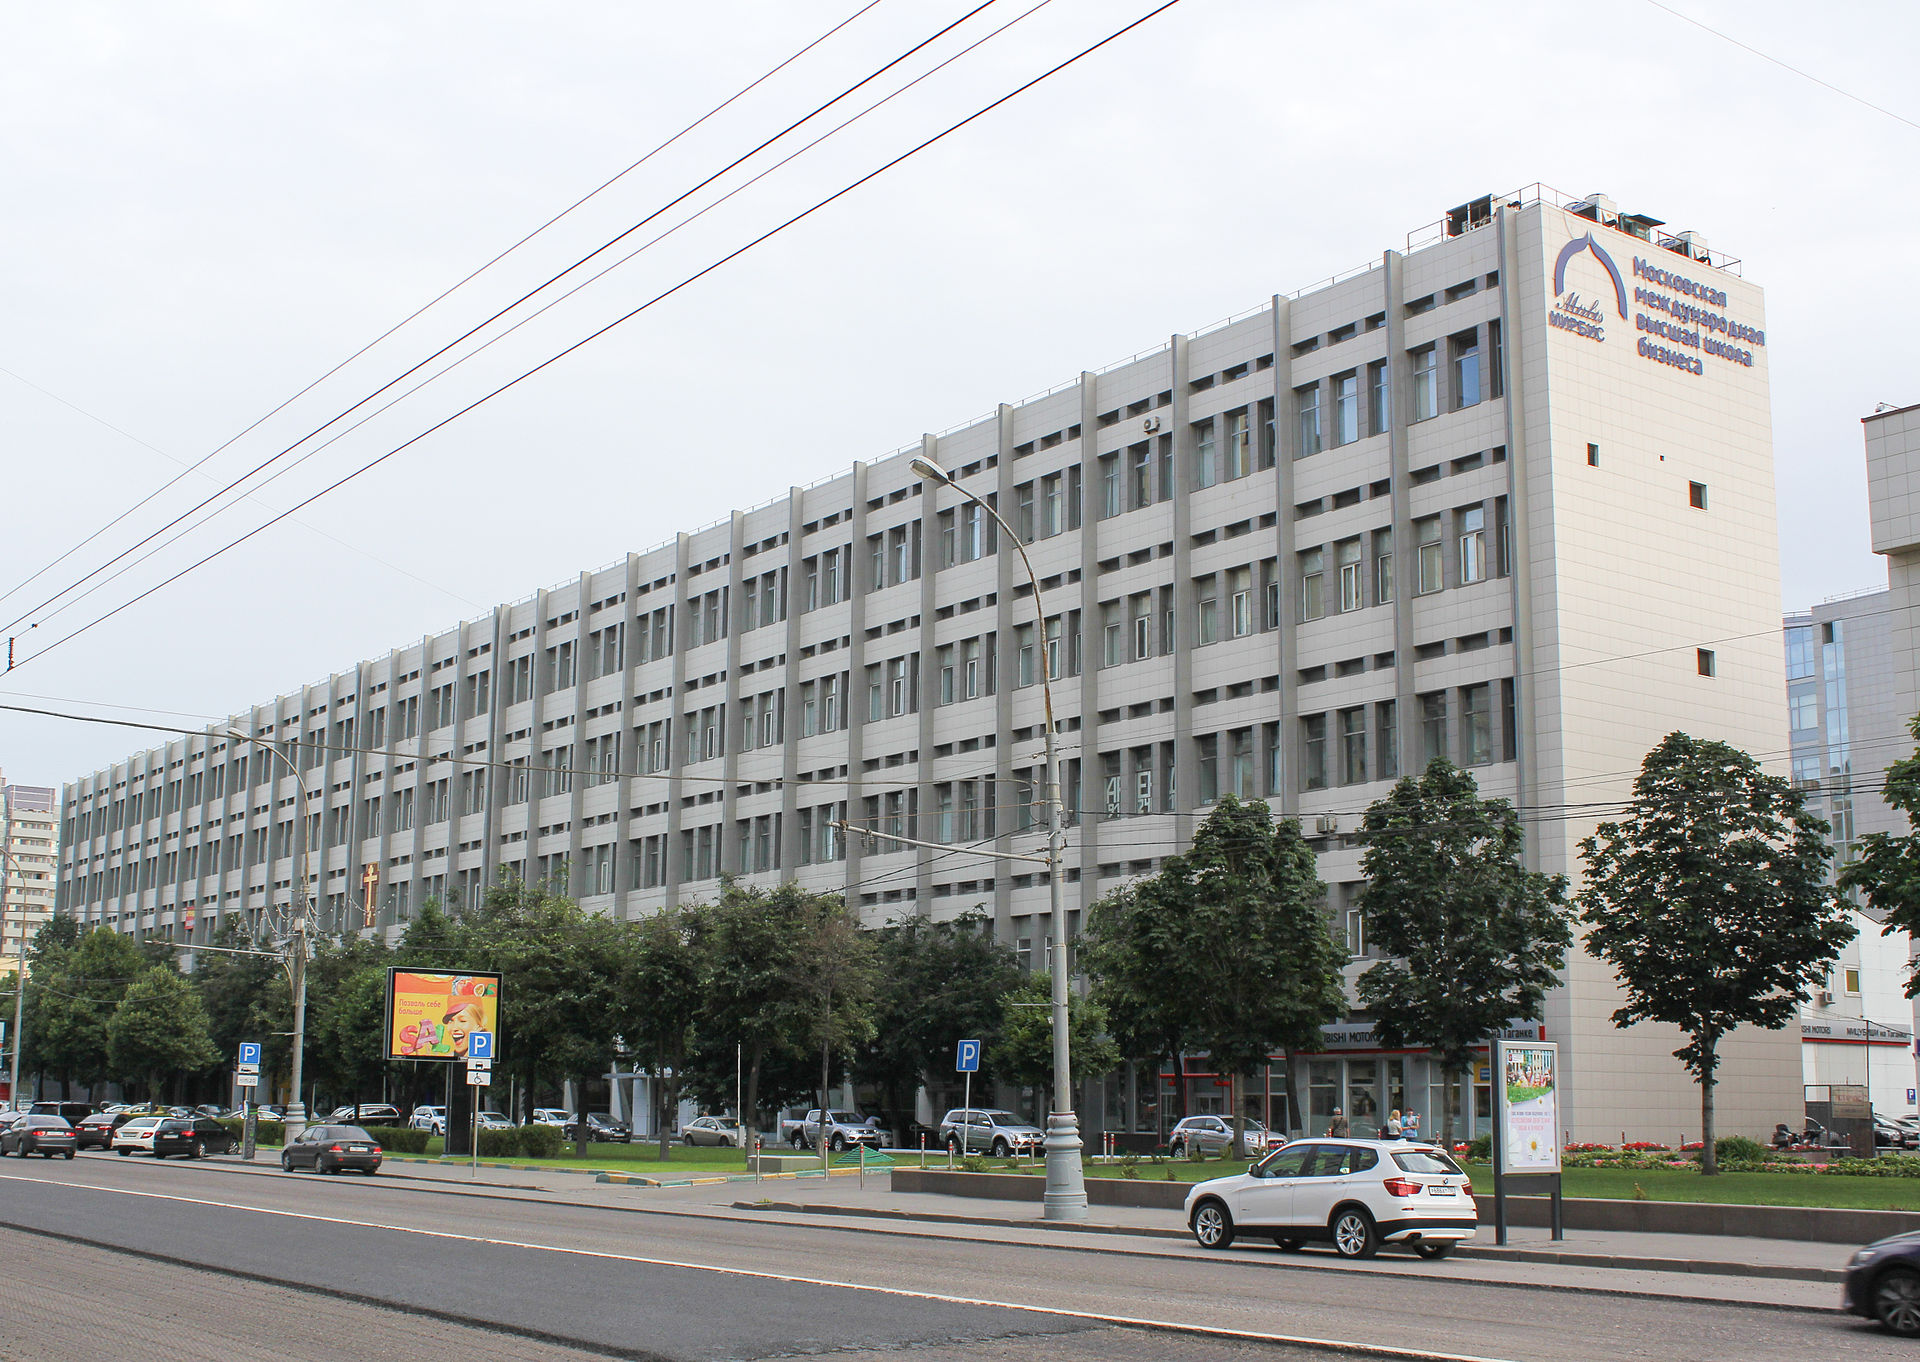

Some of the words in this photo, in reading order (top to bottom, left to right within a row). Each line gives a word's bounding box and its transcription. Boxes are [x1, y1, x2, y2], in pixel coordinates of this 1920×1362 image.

[1633, 255, 1727, 308] Московская
[1548, 310, 1605, 343] МИРБИС
[1635, 286, 1766, 347] международная
[1636, 313, 1701, 349] высшая
[1703, 336, 1753, 368] школа
[1637, 336, 1704, 376] бизнеса
[243, 1046, 256, 1062] P
[474, 1035, 487, 1055] P
[962, 1043, 976, 1068] P
